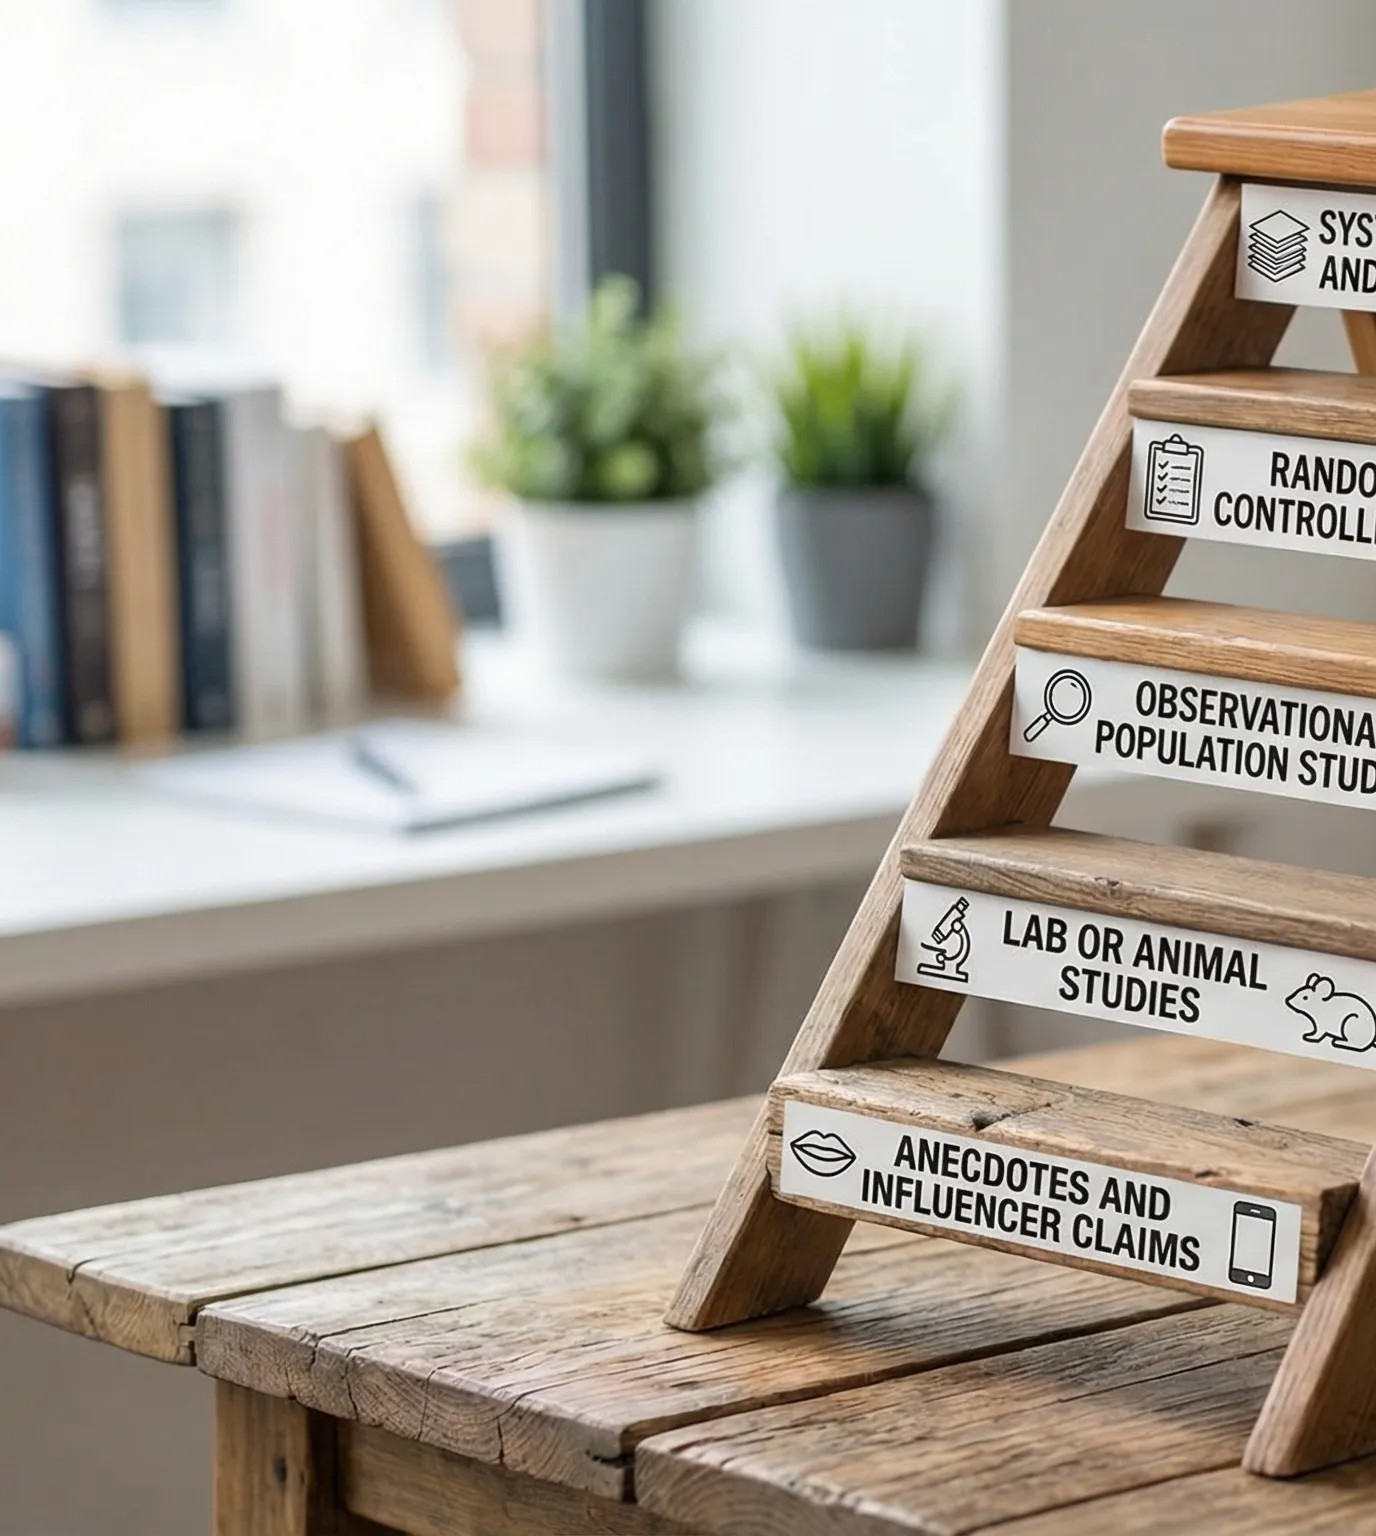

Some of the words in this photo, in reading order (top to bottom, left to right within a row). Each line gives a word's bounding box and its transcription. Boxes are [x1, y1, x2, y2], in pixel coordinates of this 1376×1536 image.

[1095, 719, 1289, 782] POPULATION
[1003, 910, 1068, 954] LAB
[1078, 923, 1124, 964] OR
[1132, 933, 1268, 991] ANIMAL
[1058, 966, 1201, 1023] STUDIES
[894, 1134, 1090, 1205] ANECDOTES
[1099, 1177, 1171, 1221] AND
[861, 1169, 1061, 1243] INFLUENCER
[1072, 1212, 1200, 1271] CLAIMS
